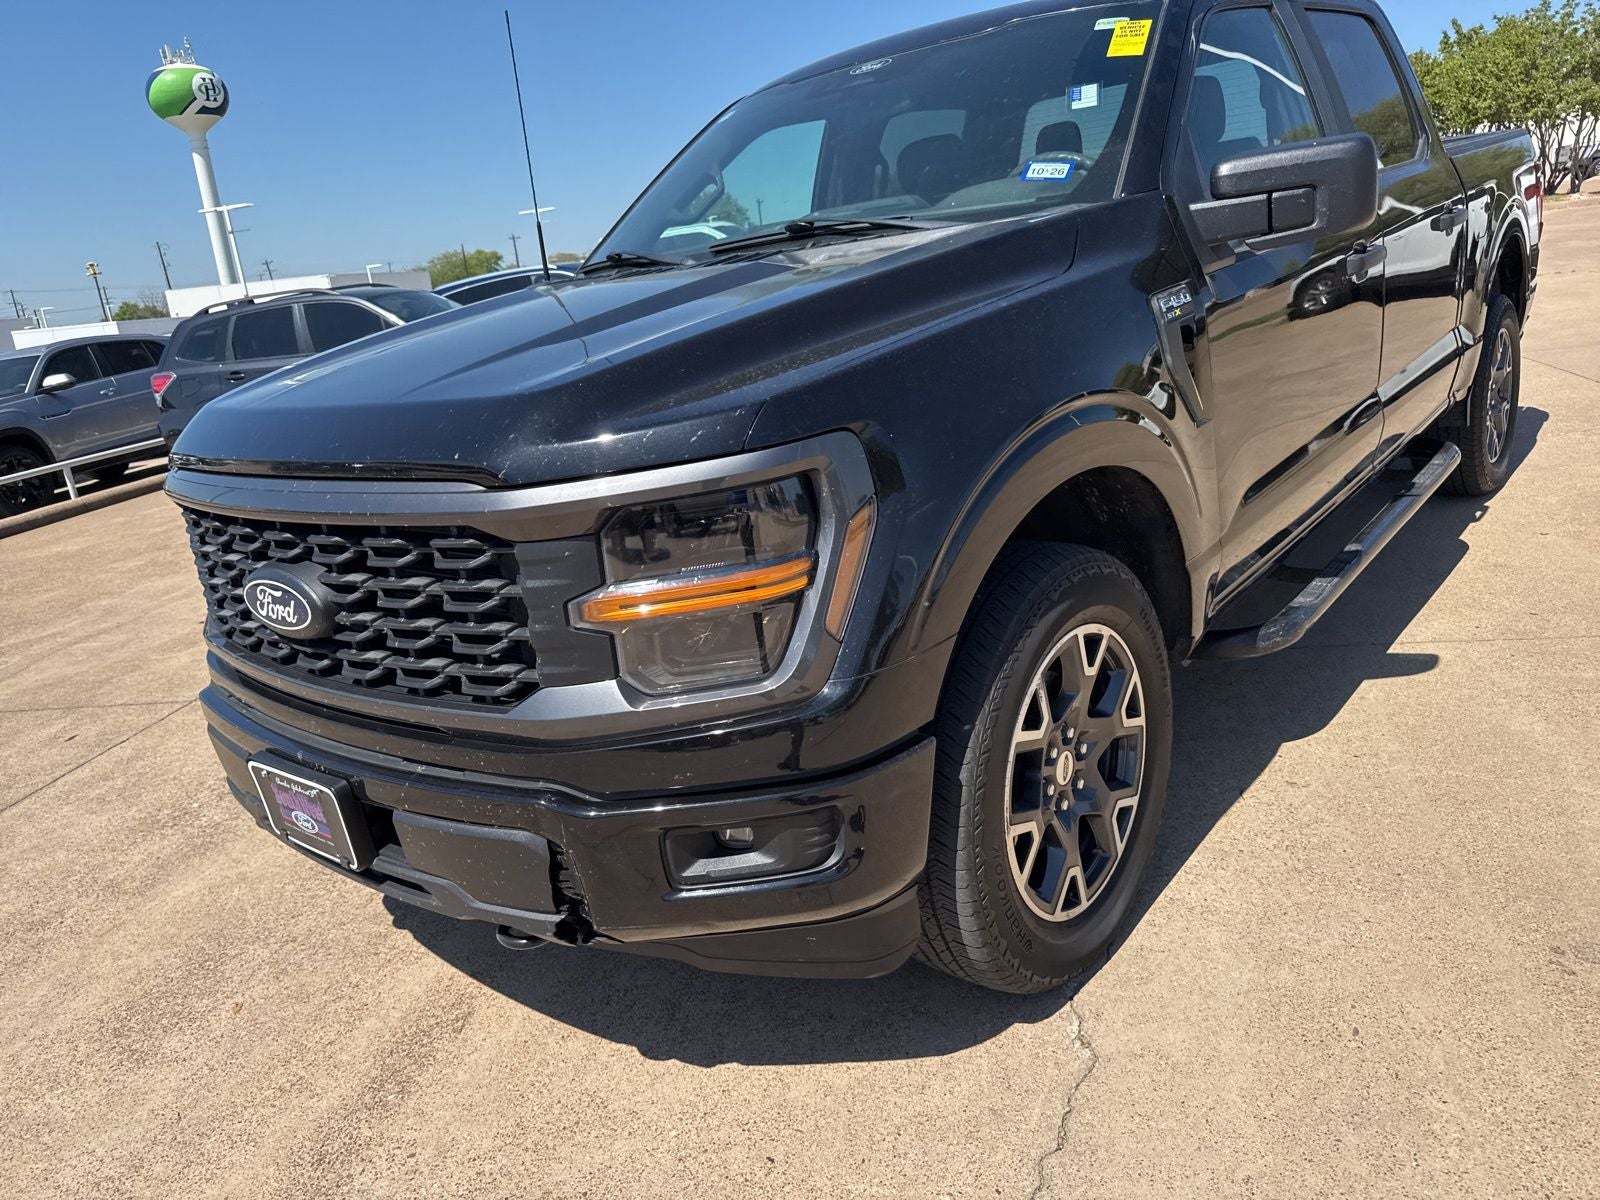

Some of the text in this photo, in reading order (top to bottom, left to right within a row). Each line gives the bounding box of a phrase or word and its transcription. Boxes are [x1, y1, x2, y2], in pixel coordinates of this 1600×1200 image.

[1167, 308, 1181, 319] STX
[256, 585, 298, 624] Ford
[297, 814, 313, 830] Ford
